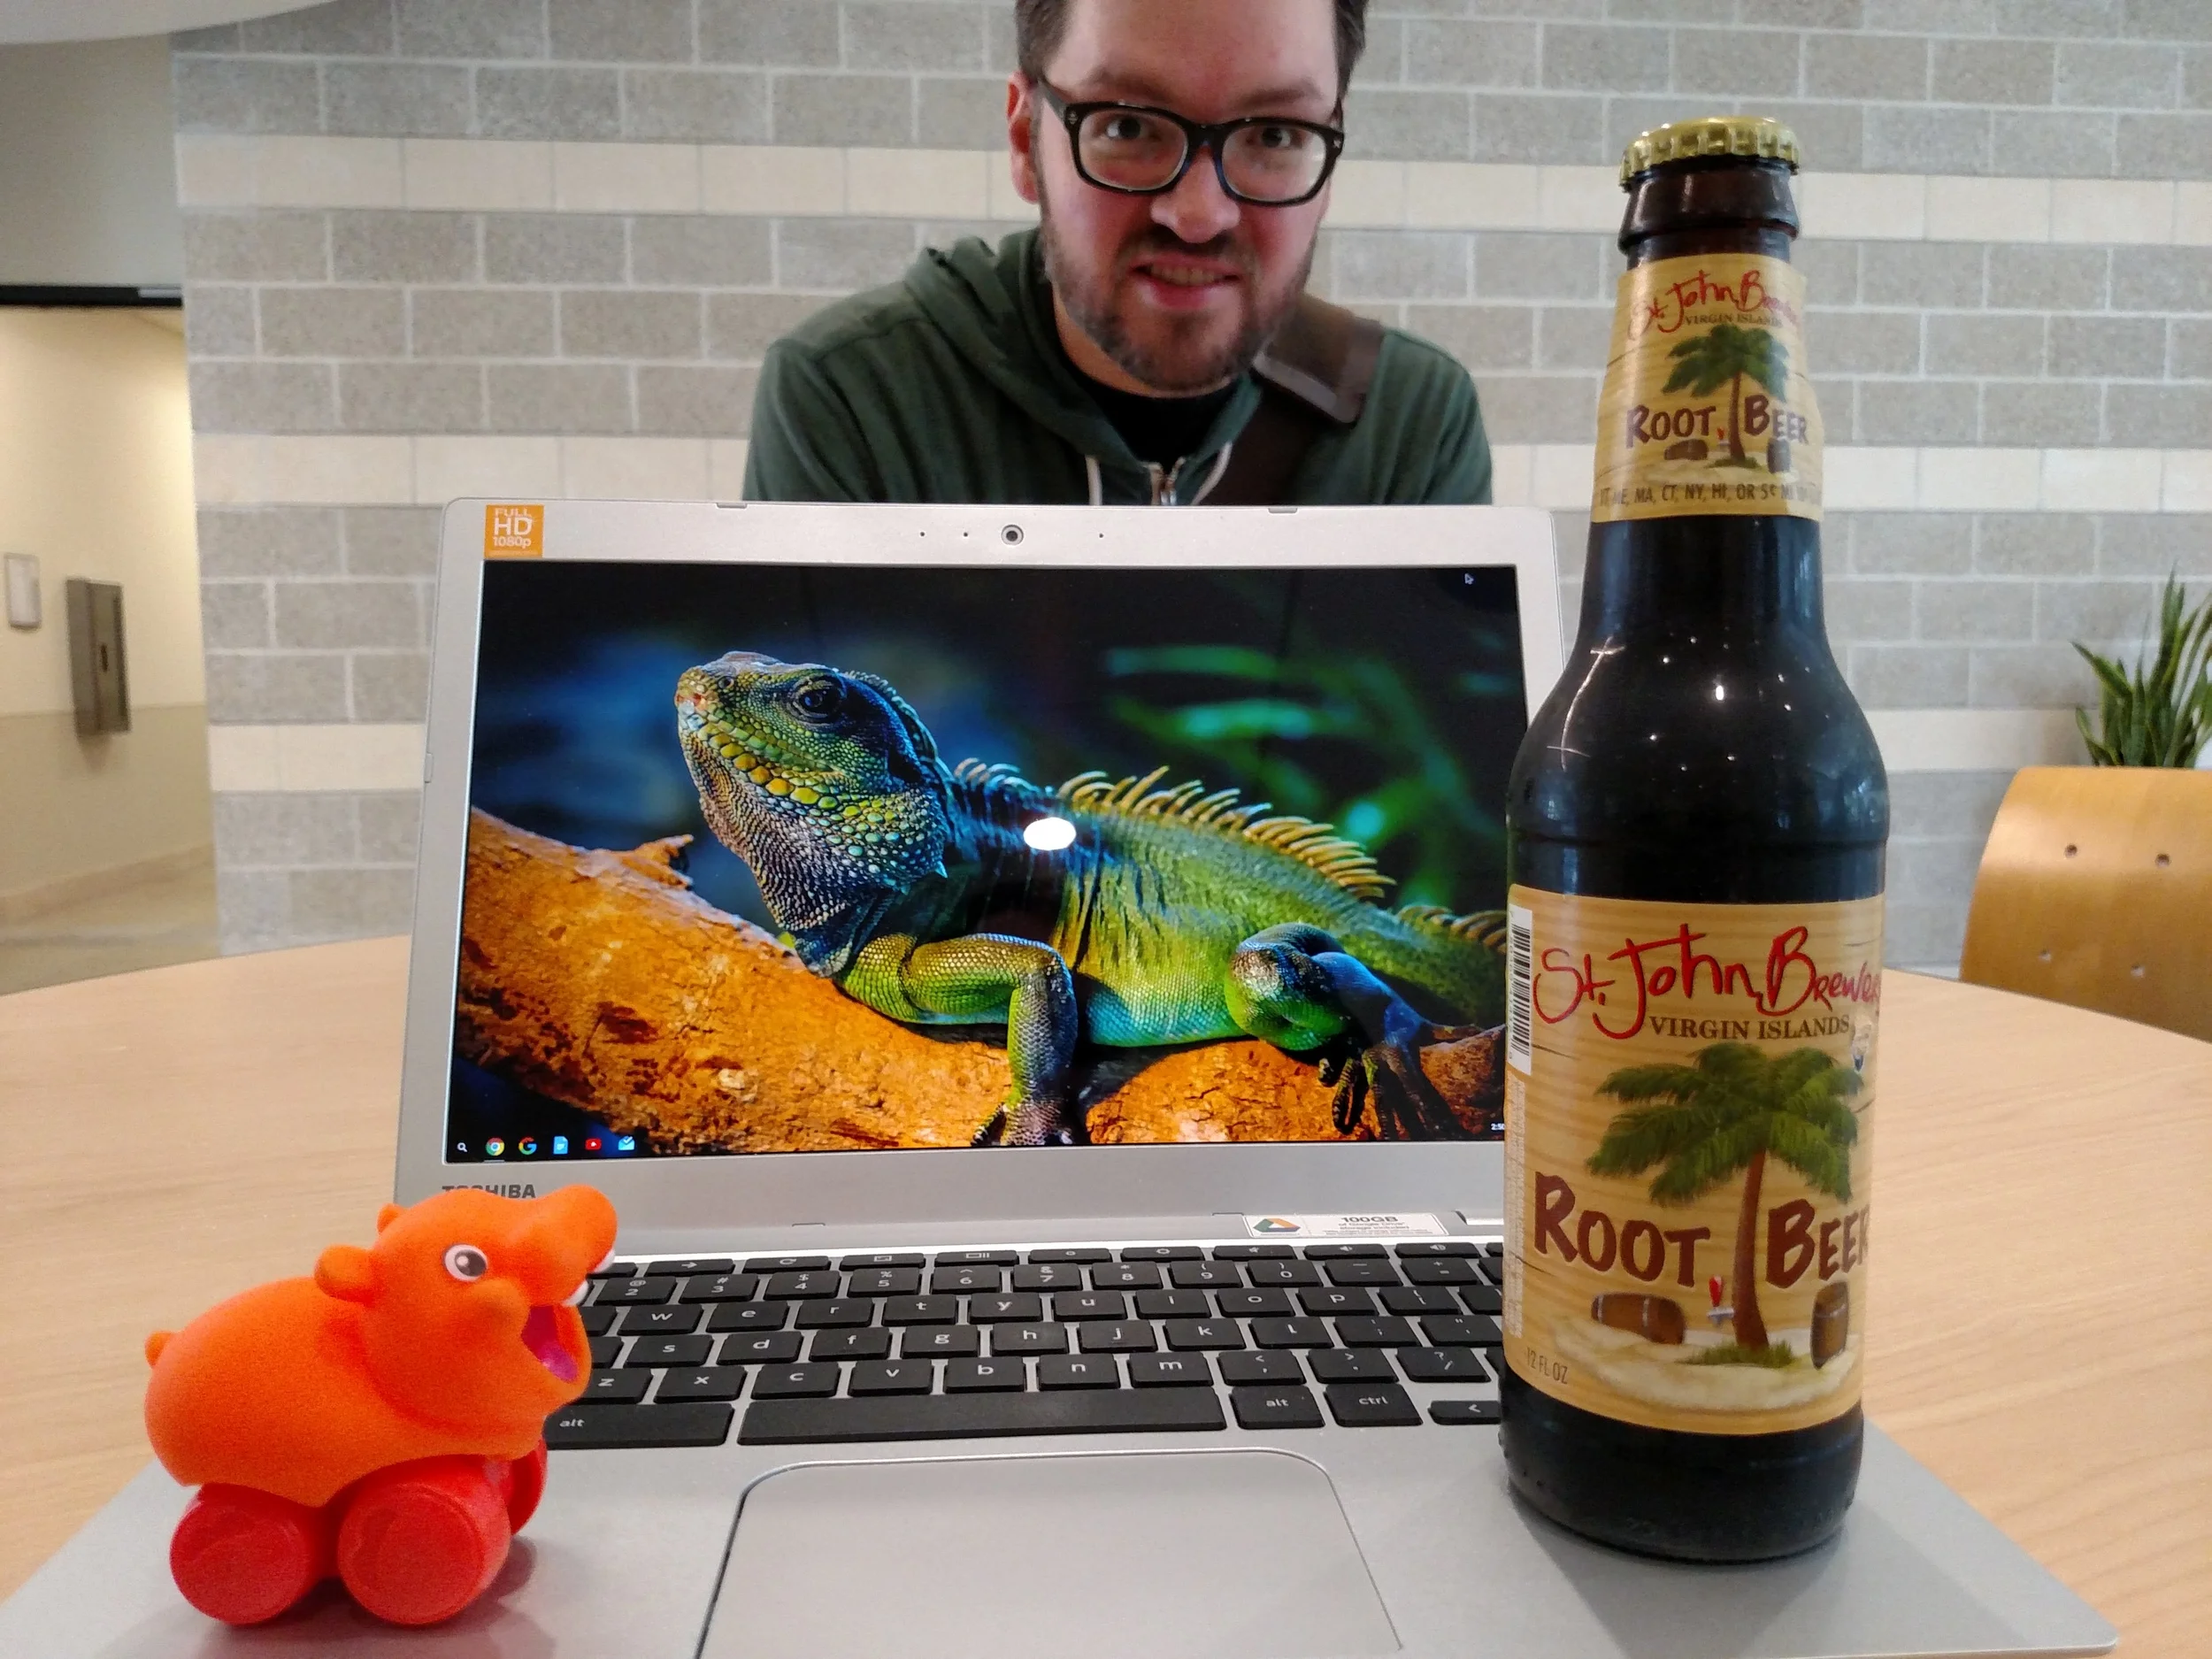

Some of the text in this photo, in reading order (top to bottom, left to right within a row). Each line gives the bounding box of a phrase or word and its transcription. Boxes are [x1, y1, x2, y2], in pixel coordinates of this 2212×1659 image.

[1657, 269, 1740, 334] John
[1685, 313, 1733, 326] VIRGIN
[1625, 393, 1809, 449] ROOT BEER
[1634, 487, 1657, 505] MA,
[1662, 483, 1679, 503] CT,
[1684, 483, 1707, 503] NY,
[1736, 483, 1756, 501] OR
[494, 508, 533, 518] FULL
[494, 517, 533, 536] HD
[492, 535, 532, 549] 1080p
[1533, 948, 1616, 1025] St.
[1592, 922, 1763, 1040] John
[1648, 1016, 1749, 1041] VIRGIN
[1755, 1014, 1851, 1041] ISLANDS
[1533, 1171, 1711, 1288] ROOT
[1040, 1274, 1054, 1283] 7
[1121, 1272, 1134, 1281] 8
[710, 1285, 724, 1294] 3
[1329, 1294, 1346, 1303] p
[915, 1302, 927, 1310] t
[997, 1301, 1011, 1311] y
[1023, 1330, 1037, 1340] h
[1112, 1327, 1122, 1340] j
[1197, 1325, 1213, 1336] k
[752, 1339, 771, 1349] d
[847, 1334, 856, 1345] f
[934, 1333, 950, 1345] g
[662, 1344, 676, 1353] s
[977, 1364, 995, 1375] b
[1071, 1363, 1087, 1372] n
[1159, 1361, 1183, 1371] m
[1525, 1346, 1569, 1385] 12 FL OZ
[789, 1372, 804, 1381] c
[886, 1369, 900, 1378] v
[598, 1378, 615, 1387] z
[694, 1376, 710, 1385] x
[1266, 1397, 1289, 1407] alt
[1358, 1394, 1388, 1405] ctrl
[559, 1417, 585, 1427] alt
